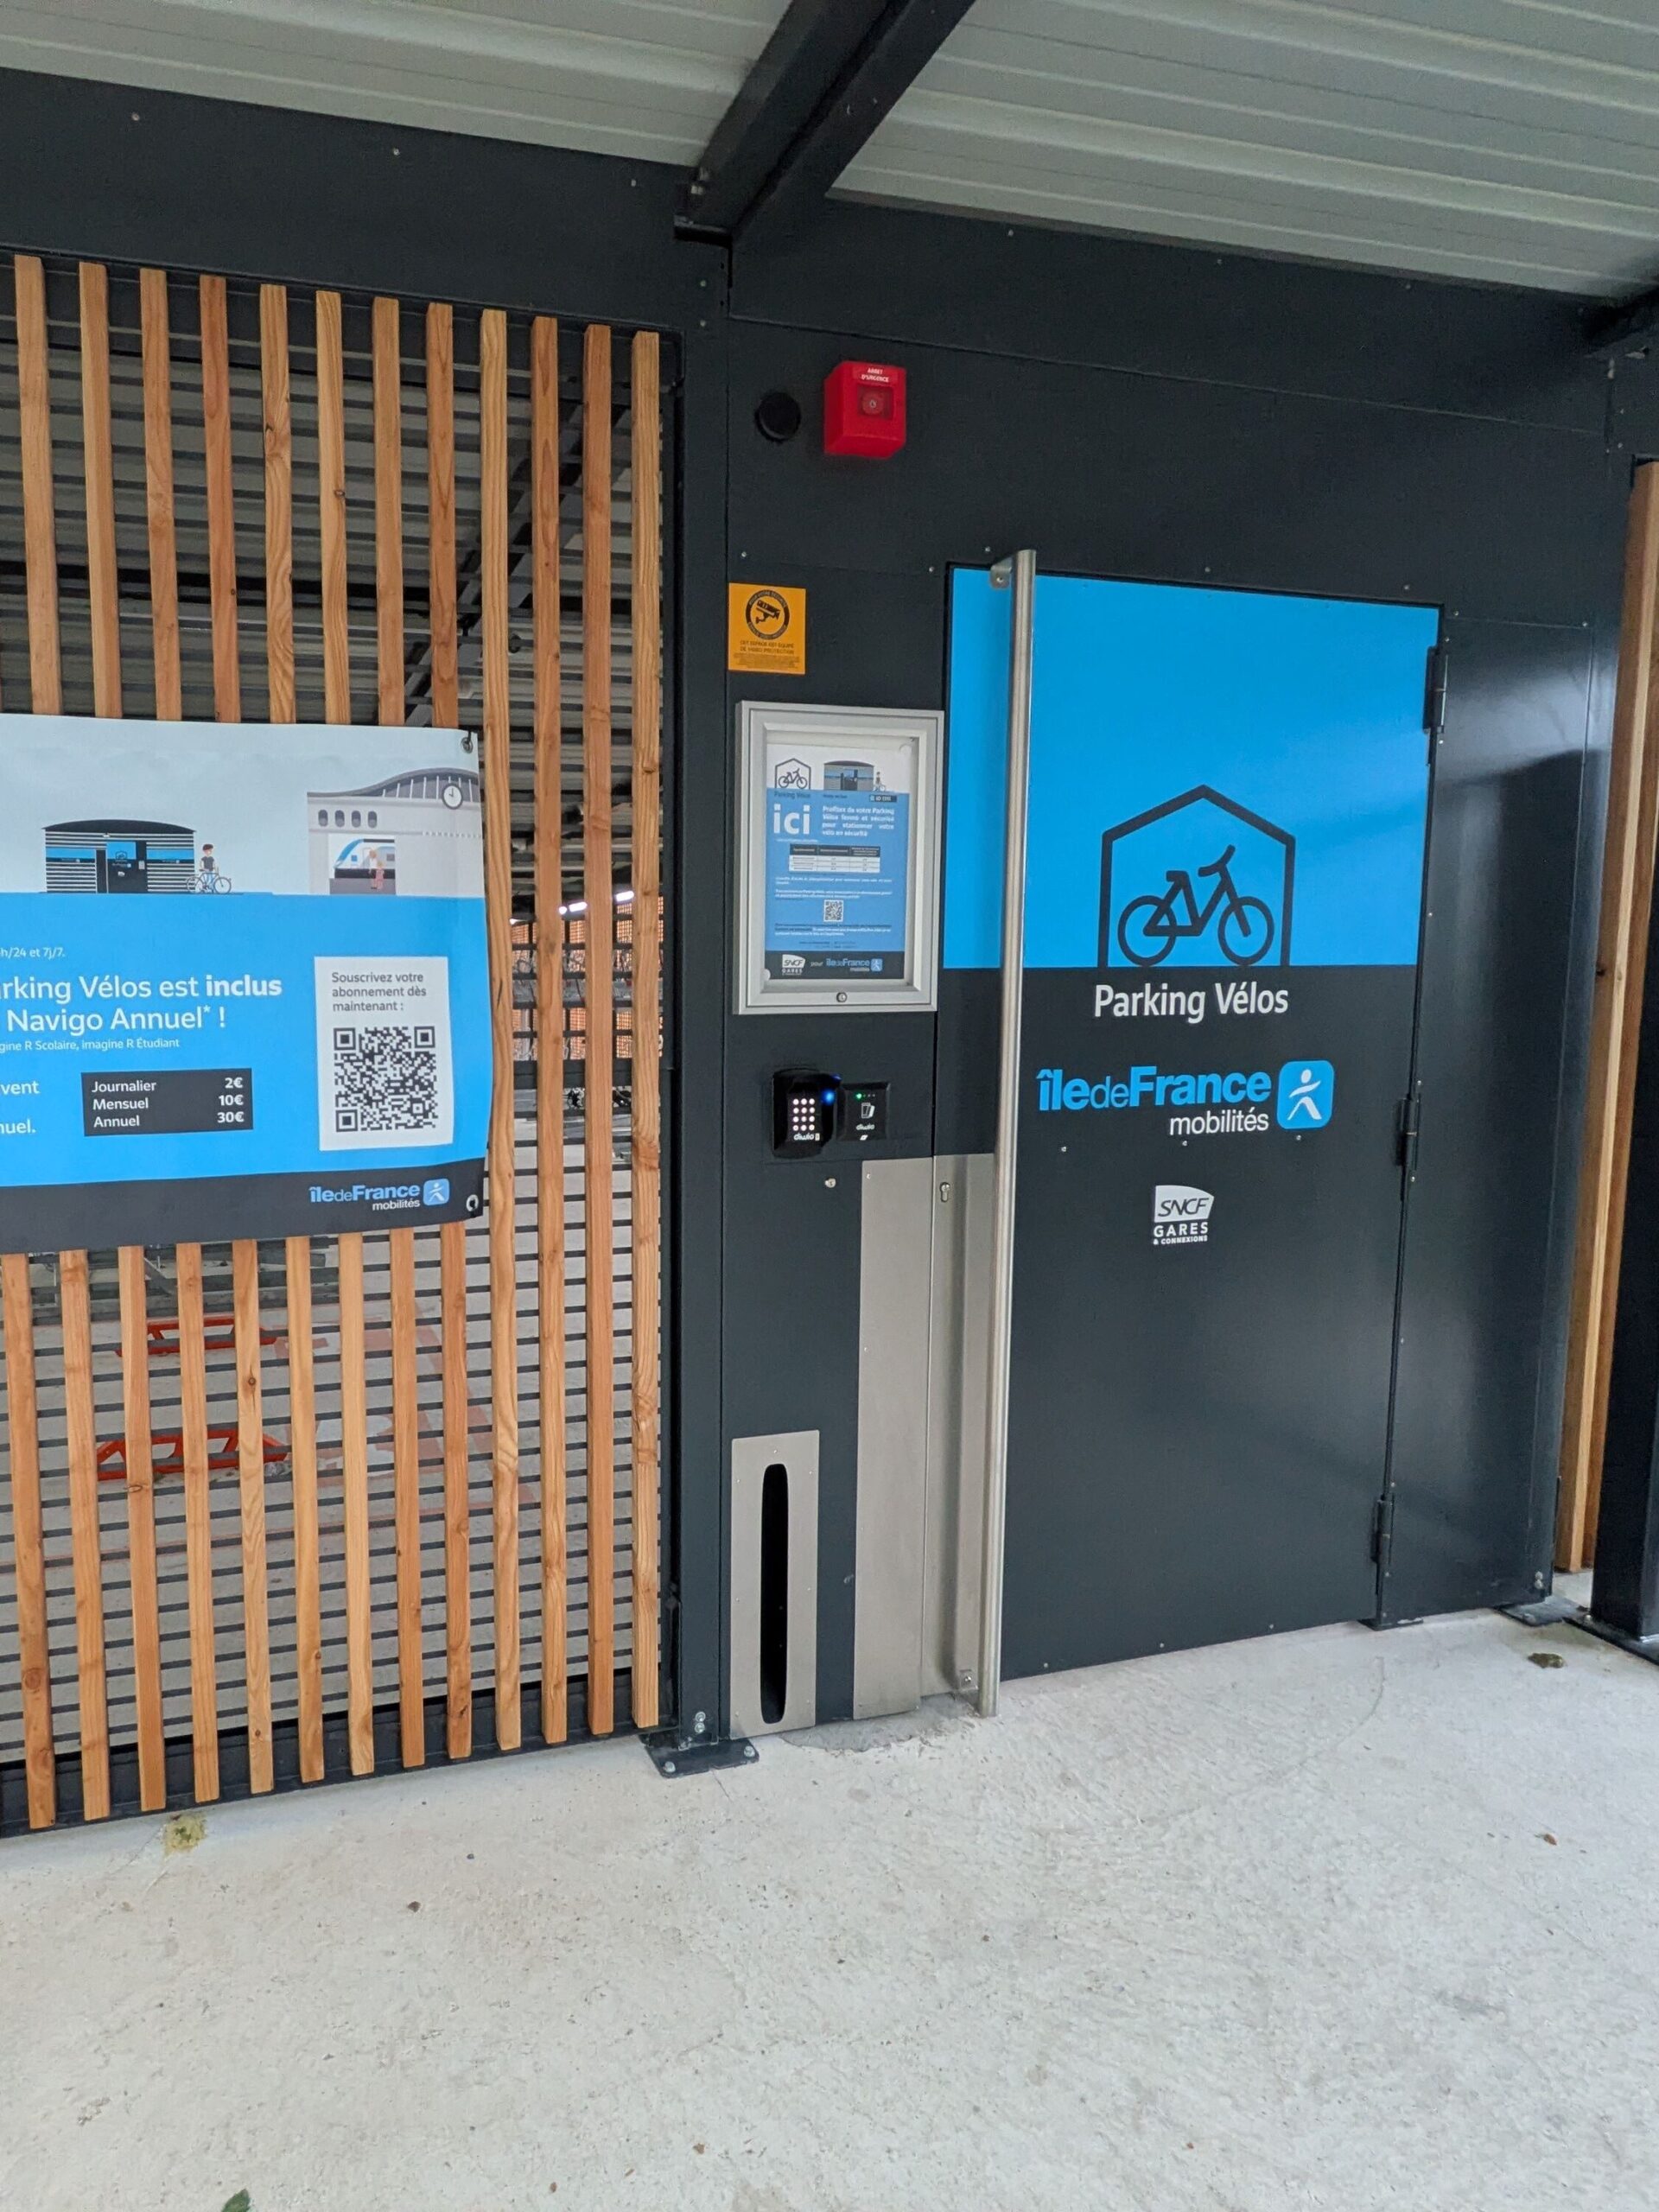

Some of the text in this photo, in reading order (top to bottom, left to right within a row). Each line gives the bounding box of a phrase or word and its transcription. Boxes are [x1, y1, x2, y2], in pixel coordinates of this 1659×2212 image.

[773, 804, 810, 835] ici
[0, 947, 66, 959] h/24 et 7j/7.
[332, 972, 423, 982] Souscrivez votre
[0, 974, 282, 1005] rking Vélos est inclus
[332, 986, 427, 997] abonnement dès
[333, 1001, 398, 1012] maintenant
[1095, 981, 1289, 1024] Parking Vélos
[7, 1008, 104, 1037] Navigo
[219, 1006, 226, 1028] !
[25, 1041, 32, 1051] R
[35, 1039, 79, 1052] Scolaire,
[82, 1039, 124, 1052] imagine
[126, 1039, 134, 1048] R
[137, 1037, 180, 1048] Étudiant
[92, 1077, 244, 1093] Journalier 2€
[92, 1095, 244, 1110] Mensuel 10€
[93, 1111, 245, 1128] Annuel 30€
[1169, 1106, 1269, 1135] mobilités
[372, 1198, 421, 1211] mobilités
[1158, 1198, 1209, 1217] SNCF
[1154, 1222, 1209, 1237] GARES
[1160, 1235, 1208, 1244] CONNEXIONS
